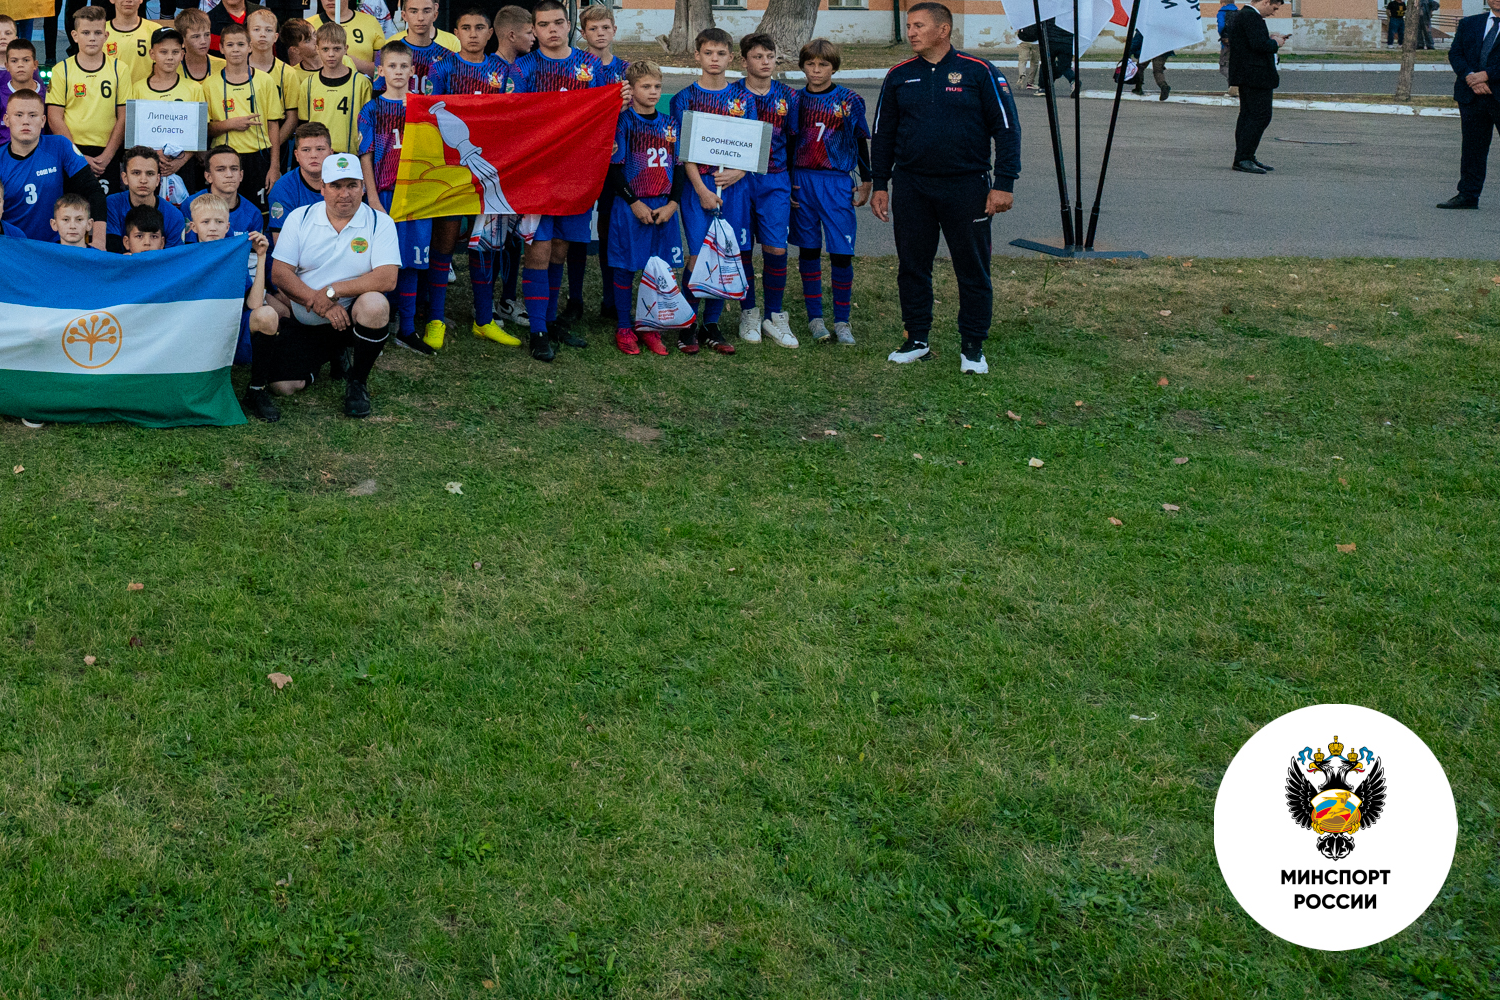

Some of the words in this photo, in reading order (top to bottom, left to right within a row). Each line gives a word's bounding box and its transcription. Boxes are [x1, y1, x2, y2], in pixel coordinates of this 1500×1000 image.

[353, 28, 364, 44] 9
[136, 39, 147, 57] 5
[100, 80, 112, 99] 6
[336, 96, 349, 115] 4
[147, 111, 188, 122] Липецкая
[151, 126, 184, 134] область
[392, 128, 403, 149] 1
[815, 122, 826, 142] 7
[701, 135, 753, 149] ВОРОНЕЖСКАЯ
[647, 147, 669, 168] 22
[709, 147, 742, 158] ОБЛАСТЬ
[36, 168, 49, 177] СОШ
[24, 183, 38, 205] 3
[413, 245, 430, 265] 13
[671, 246, 683, 264] 2
